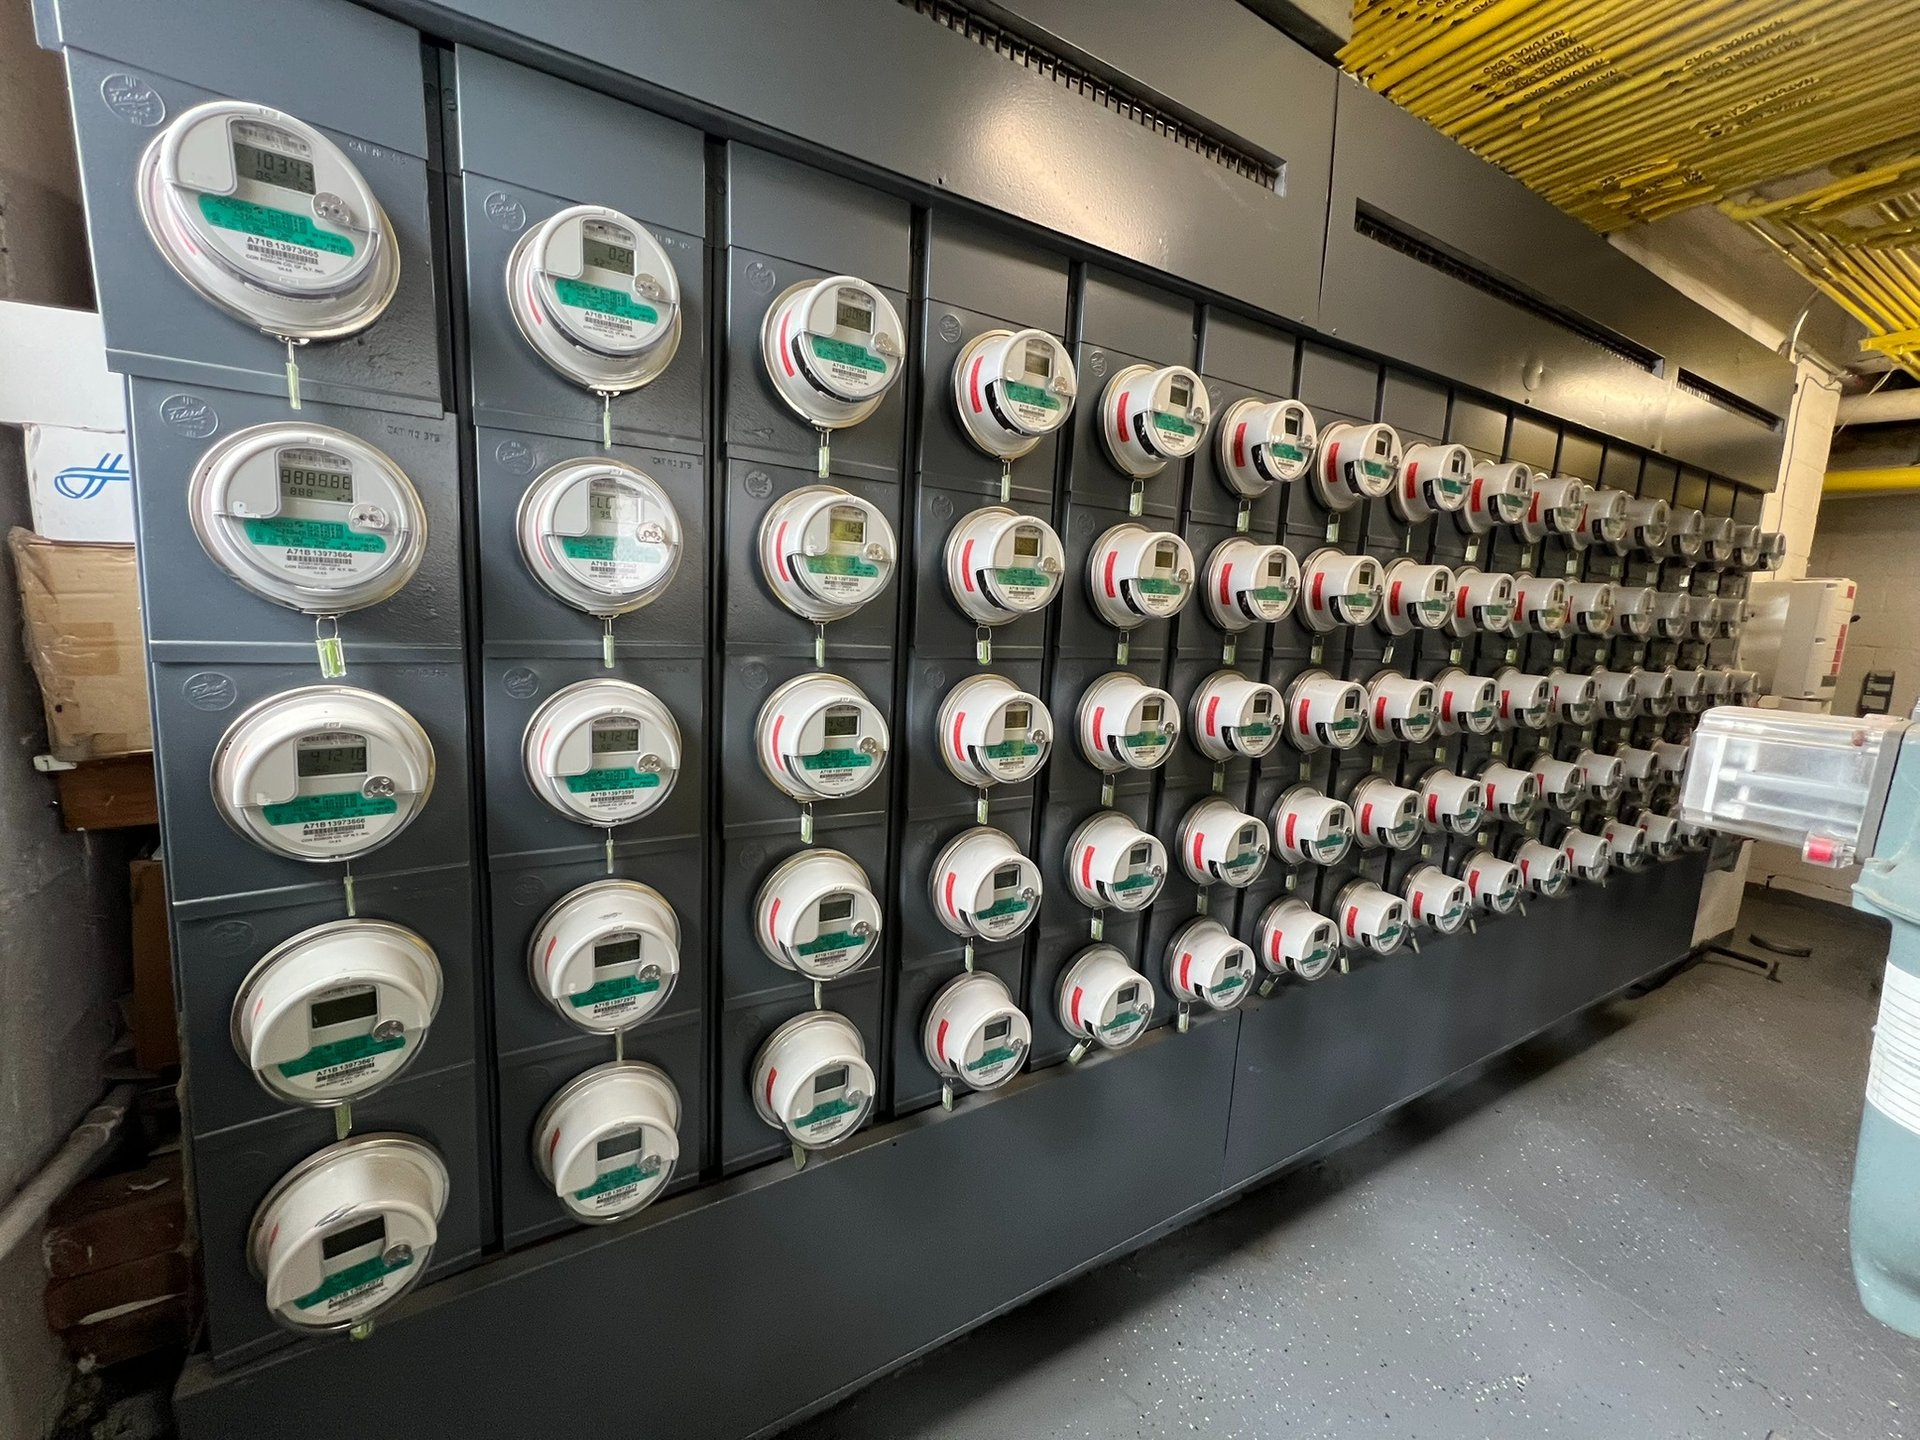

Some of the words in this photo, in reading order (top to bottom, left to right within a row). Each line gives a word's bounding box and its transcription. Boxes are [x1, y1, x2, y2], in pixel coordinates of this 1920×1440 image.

[1509, 29, 1566, 60] NATURAL
[1482, 58, 1508, 74] GAS
[247, 235, 274, 248] A71B
[286, 548, 311, 556] A71B
[303, 822, 326, 830] A71B
